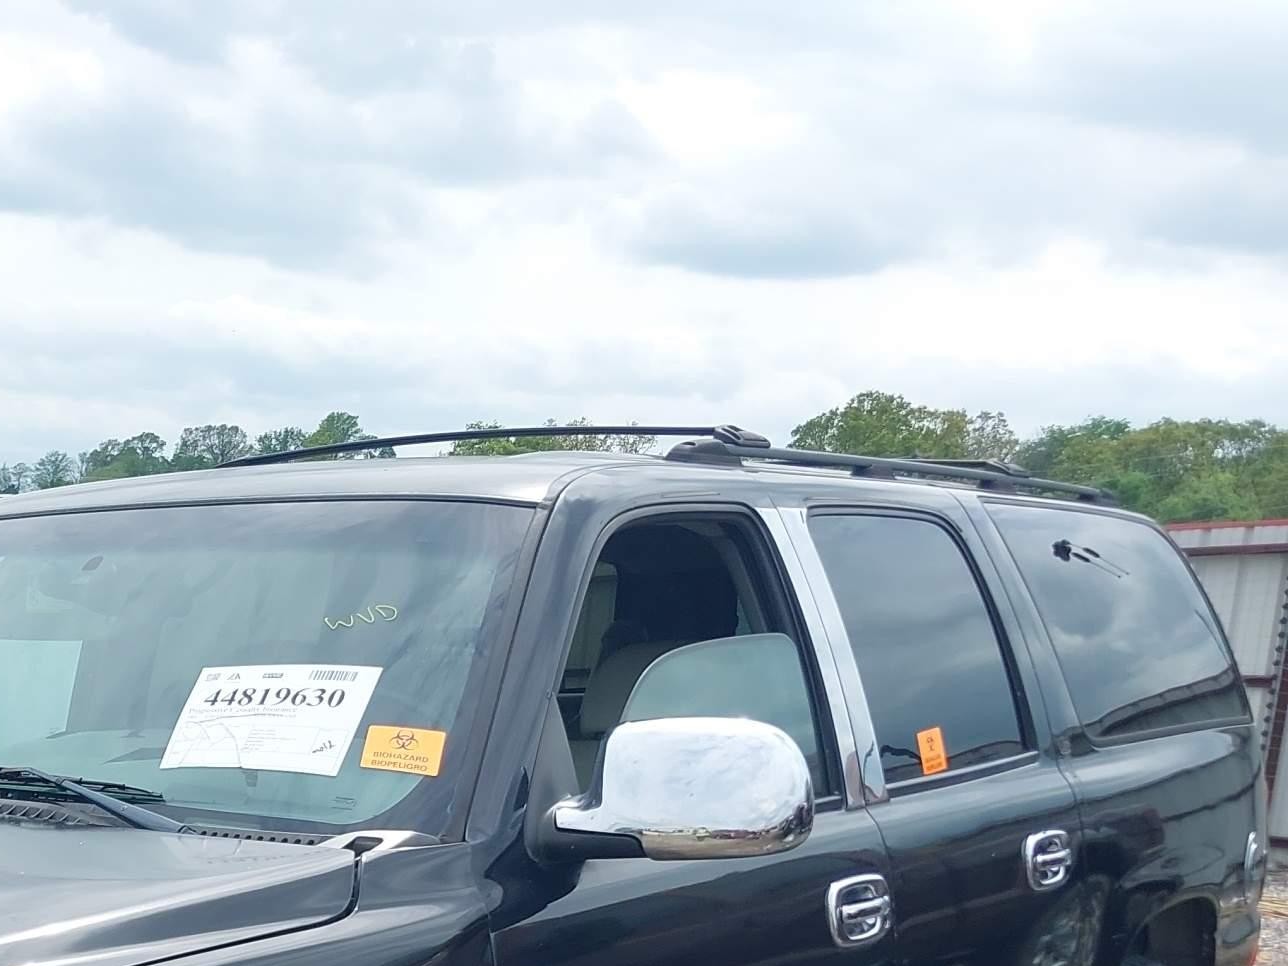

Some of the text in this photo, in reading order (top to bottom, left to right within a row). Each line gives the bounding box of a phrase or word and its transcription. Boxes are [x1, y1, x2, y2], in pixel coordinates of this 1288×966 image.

[203, 686, 346, 708] 44819630
[373, 751, 429, 763] BIOHAZARD
[370, 759, 428, 772] BIOPELIGRO
